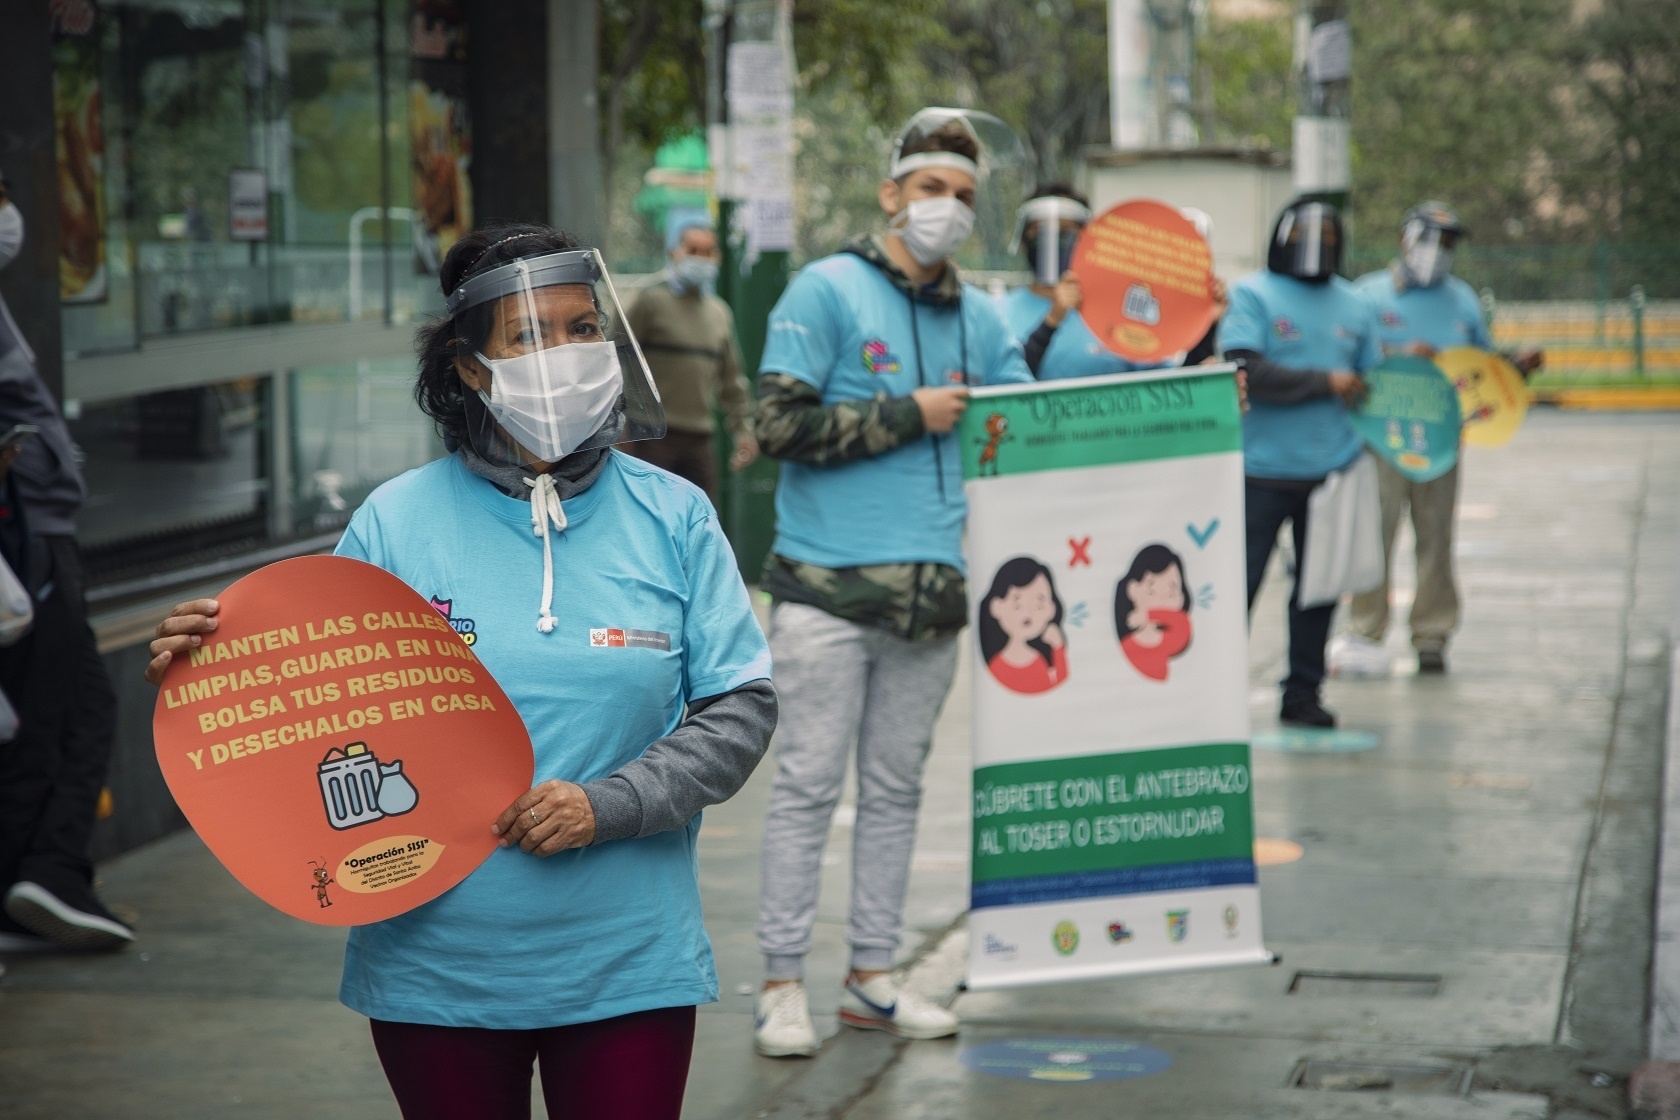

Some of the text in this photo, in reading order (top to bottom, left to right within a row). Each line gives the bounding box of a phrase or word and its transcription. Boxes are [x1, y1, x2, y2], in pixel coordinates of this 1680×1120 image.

[189, 611, 449, 668] MANTEN LAS CALLES
[396, 639, 431, 657] EN
[435, 639, 479, 664] UNA
[608, 633, 623, 641] PERÚ
[198, 666, 475, 733] BOLSA TUS RESIDUOS
[186, 693, 496, 770] Y DESECHALOS EN CASA
[1059, 777, 1103, 809] CON
[1105, 774, 1132, 804] EL
[1133, 764, 1249, 799] ANTEBRAZO
[978, 805, 1225, 857] AL TOSER O ESTORNUDAR
